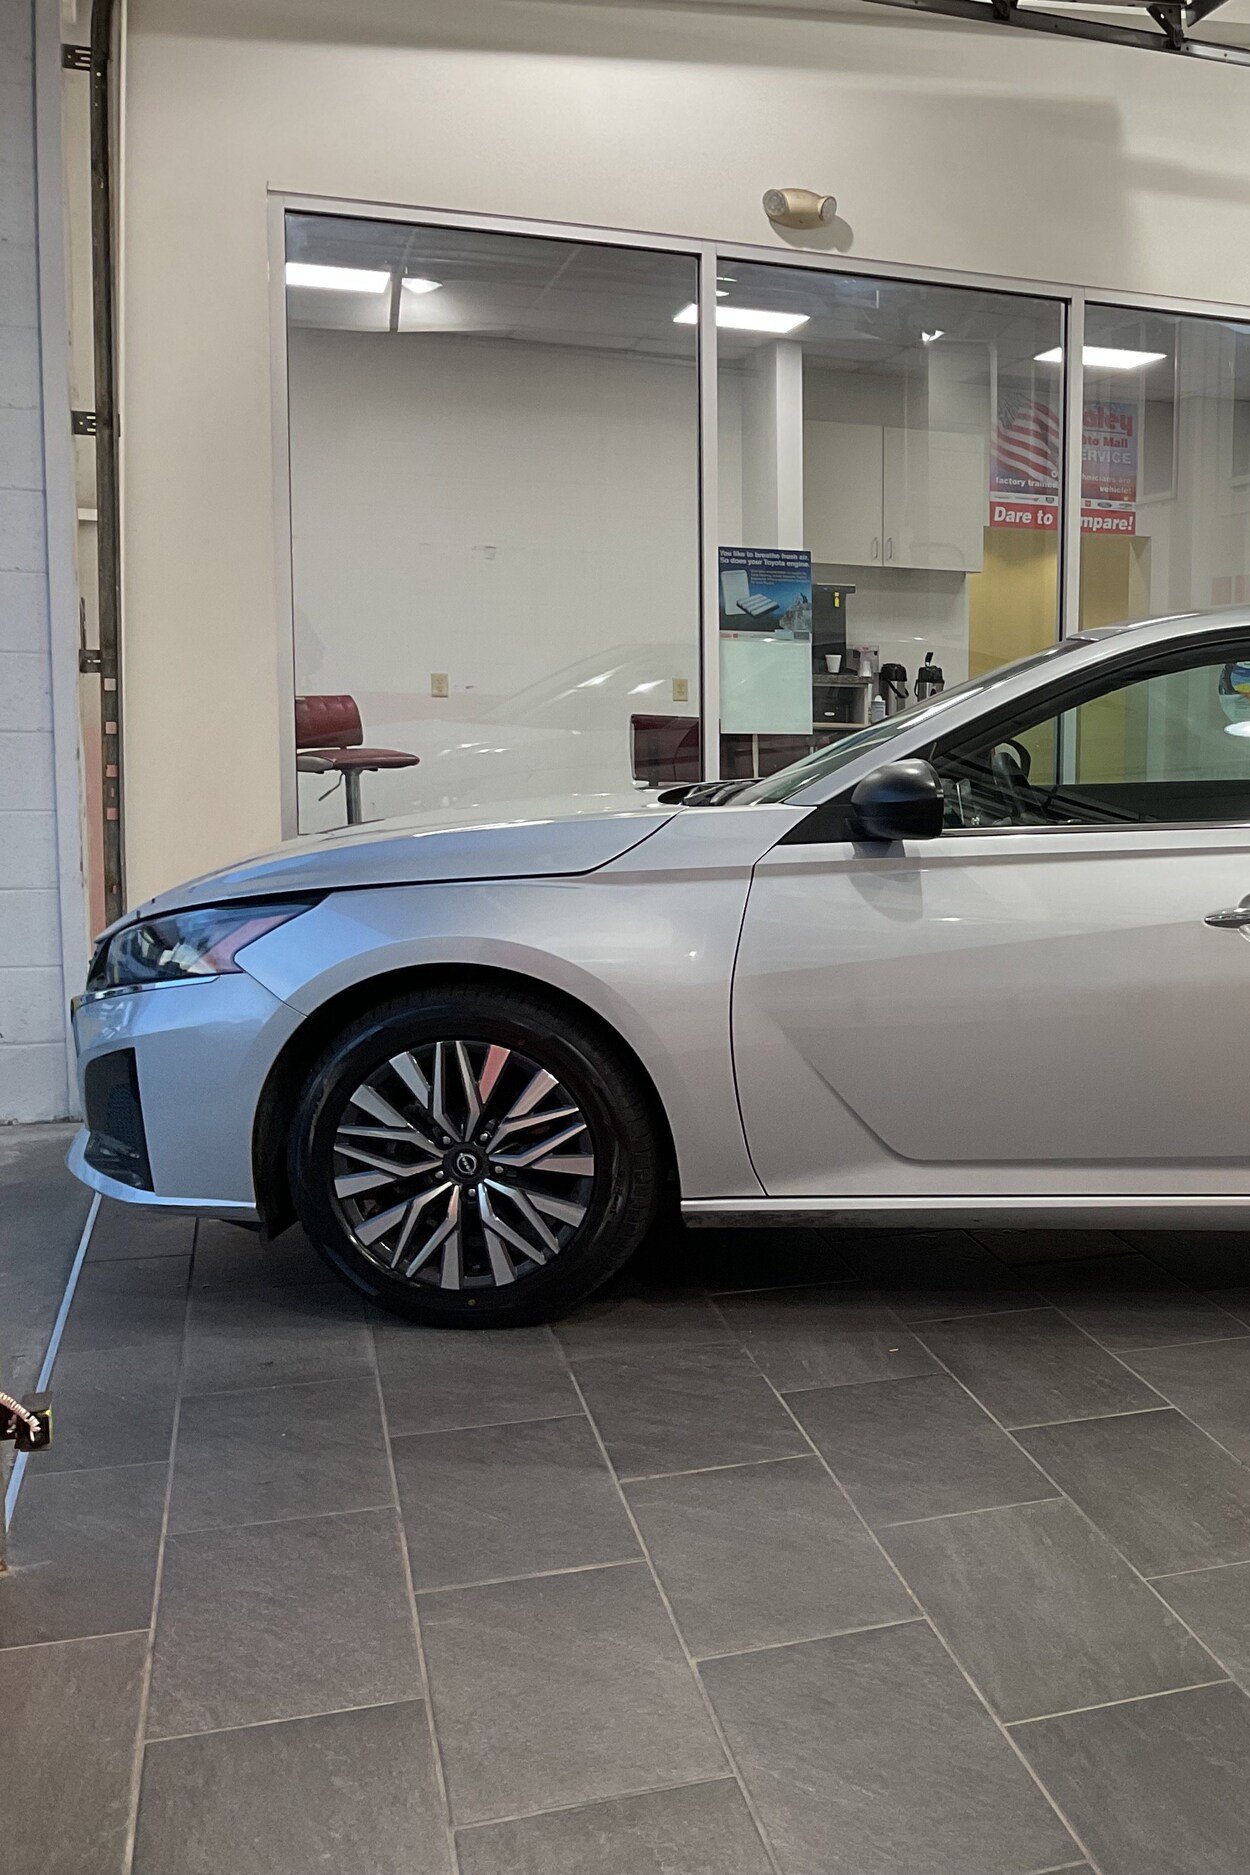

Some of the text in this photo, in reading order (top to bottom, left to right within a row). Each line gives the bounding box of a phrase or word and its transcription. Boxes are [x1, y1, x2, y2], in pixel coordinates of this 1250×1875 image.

[1082, 406, 1133, 437] aley
[1082, 449, 1131, 464] ERVICE
[995, 477, 1026, 487] factory
[994, 506, 1133, 531] Dare to mpare!
